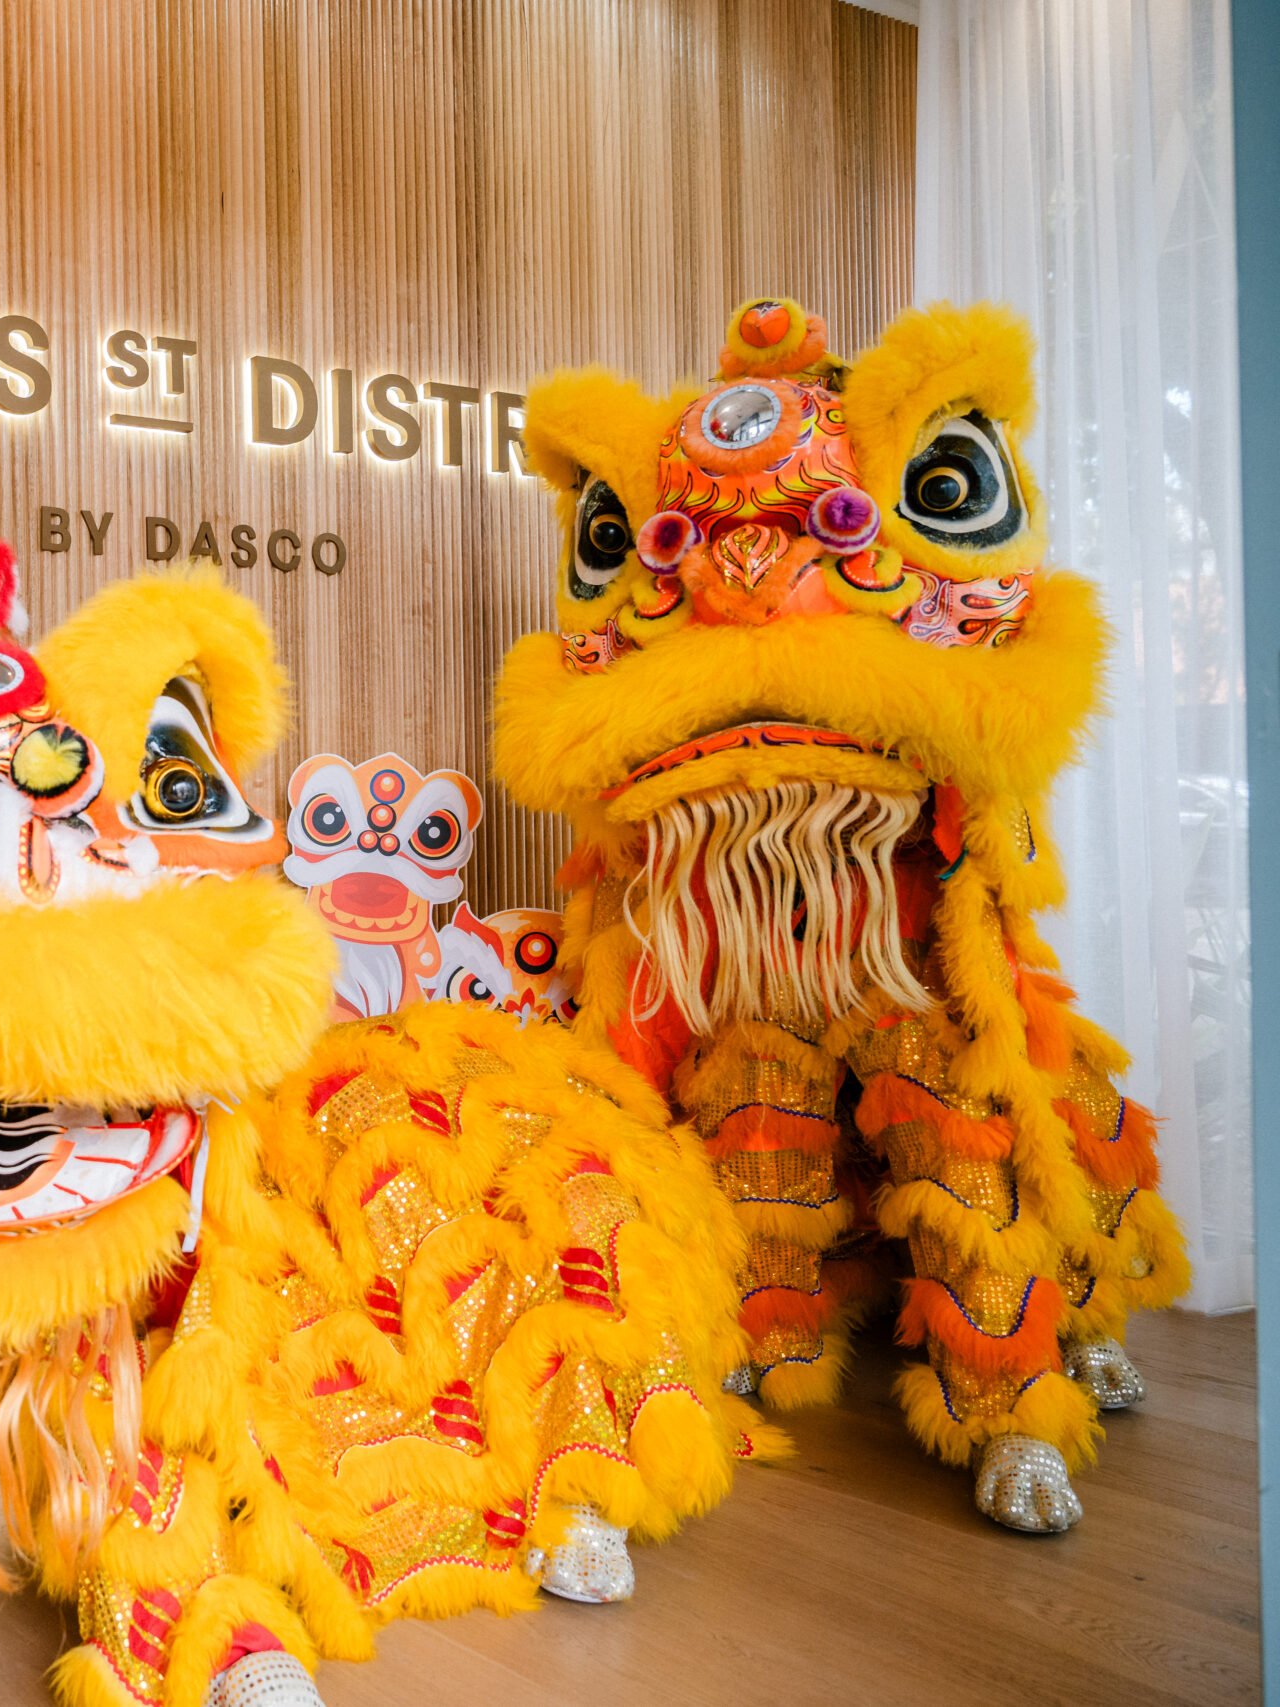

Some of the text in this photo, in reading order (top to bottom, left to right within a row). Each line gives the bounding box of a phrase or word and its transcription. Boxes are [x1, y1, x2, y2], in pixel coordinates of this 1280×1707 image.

[106, 330, 197, 396] ST
[40, 506, 347, 577] BY DASCO
